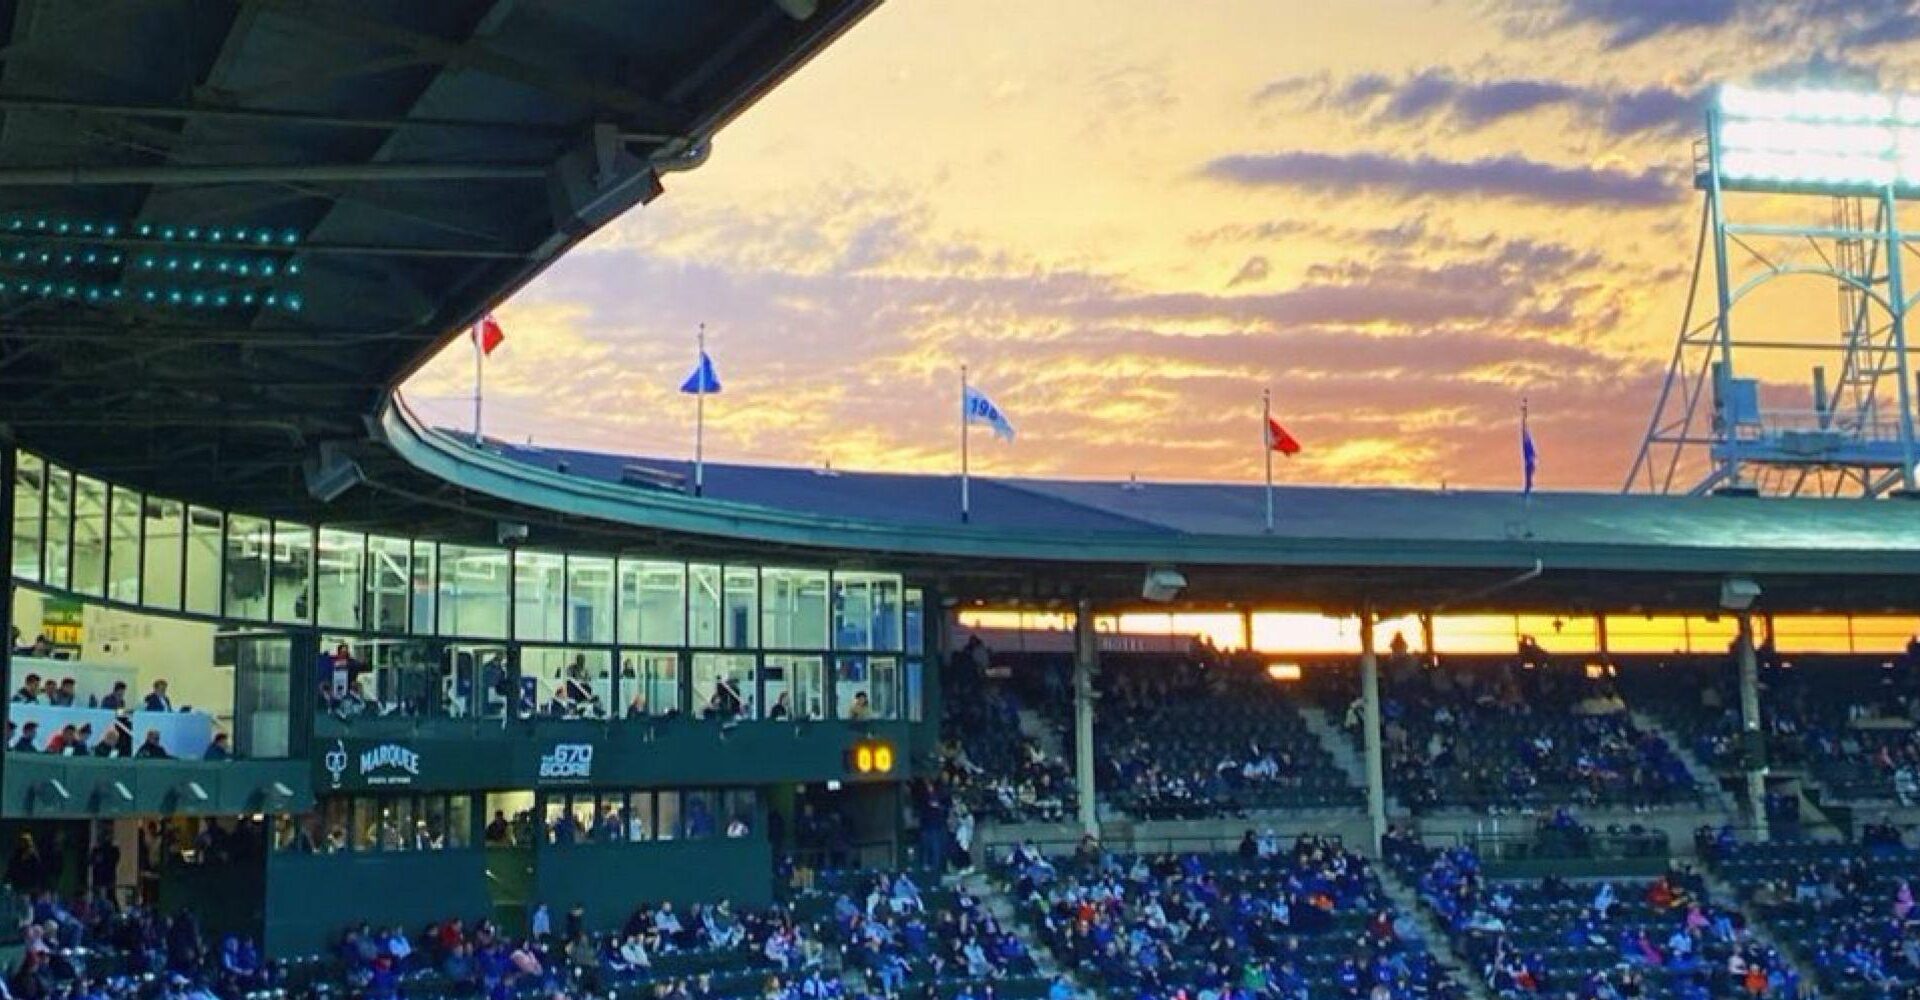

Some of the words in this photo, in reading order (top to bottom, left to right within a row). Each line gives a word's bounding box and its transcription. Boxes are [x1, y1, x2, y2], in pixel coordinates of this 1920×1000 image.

[361, 744, 419, 775] MARQUEE
[555, 744, 593, 763] 670
[540, 762, 591, 777] SCORE
